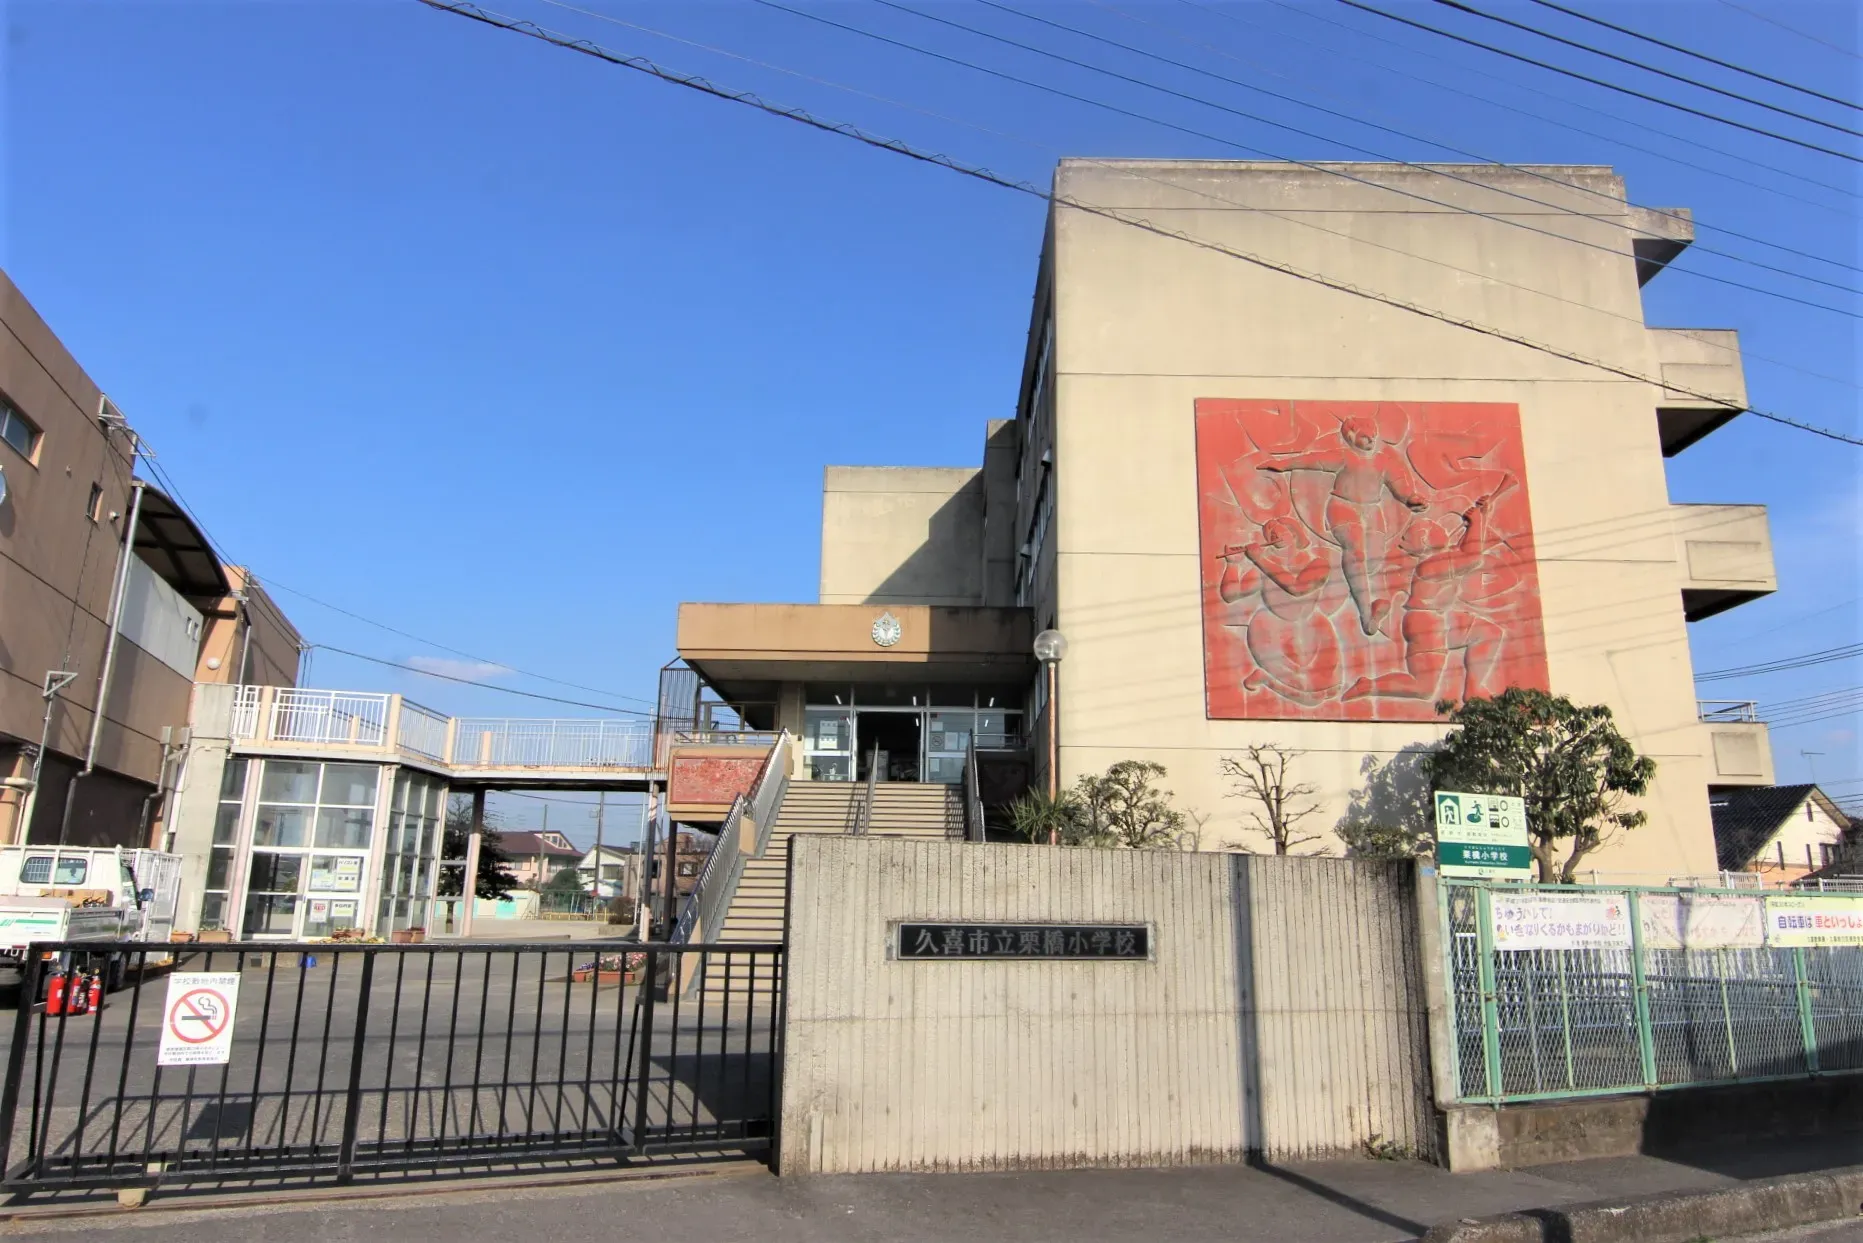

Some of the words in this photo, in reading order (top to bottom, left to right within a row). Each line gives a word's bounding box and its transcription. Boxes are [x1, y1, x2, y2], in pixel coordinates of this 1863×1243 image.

[1778, 915, 1813, 929] 自転車は
[914, 927, 1137, 955] 久喜市立栗橋小学校
